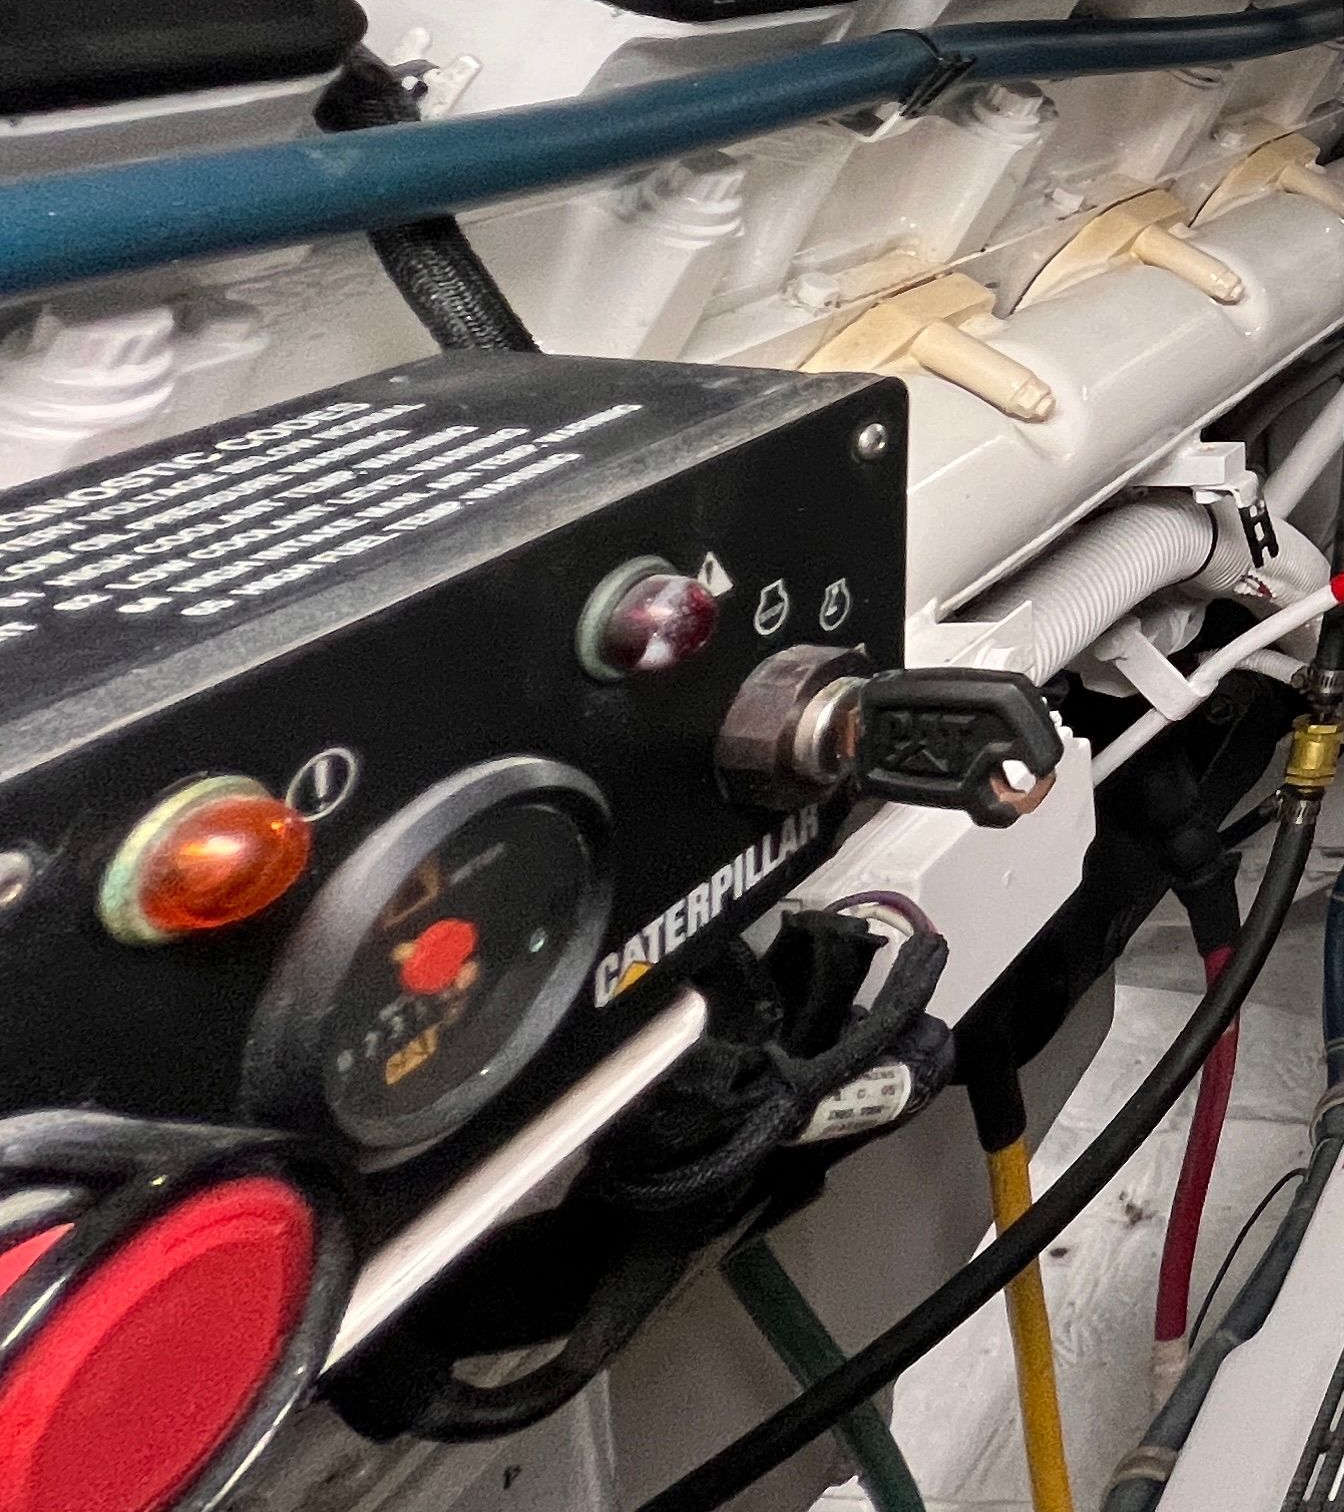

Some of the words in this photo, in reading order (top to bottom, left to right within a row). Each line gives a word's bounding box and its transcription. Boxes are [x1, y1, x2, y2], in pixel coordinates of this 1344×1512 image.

[0, 452, 225, 532] GNOSTIC
[214, 402, 372, 450] CODES
[43, 554, 148, 586] HIGH
[131, 499, 286, 553] COOLANT
[351, 425, 480, 468] WARNING
[53, 594, 114, 611] 62
[105, 559, 201, 589] LOW
[186, 504, 338, 559] COOLANT
[324, 470, 424, 504] LEVEL
[405, 428, 530, 471] WARNING
[68, 531, 142, 551] OIL
[124, 473, 296, 529] PRESSURE
[277, 429, 411, 472] WARNING
[74, 473, 231, 520] VOLTAGE
[212, 439, 323, 473] BELOW
[310, 403, 426, 439] NORMAL
[116, 596, 174, 613] 64
[166, 561, 270, 592] HIGH
[248, 517, 376, 560] INTAKE
[425, 470, 484, 490] AIR
[532, 404, 643, 443] WARNING
[180, 599, 240, 617] 65
[228, 563, 329, 595] HIGH
[305, 532, 411, 563] FUEL
[458, 452, 584, 500] WARNING
[594, 804, 818, 1008] CATERPILLAR
